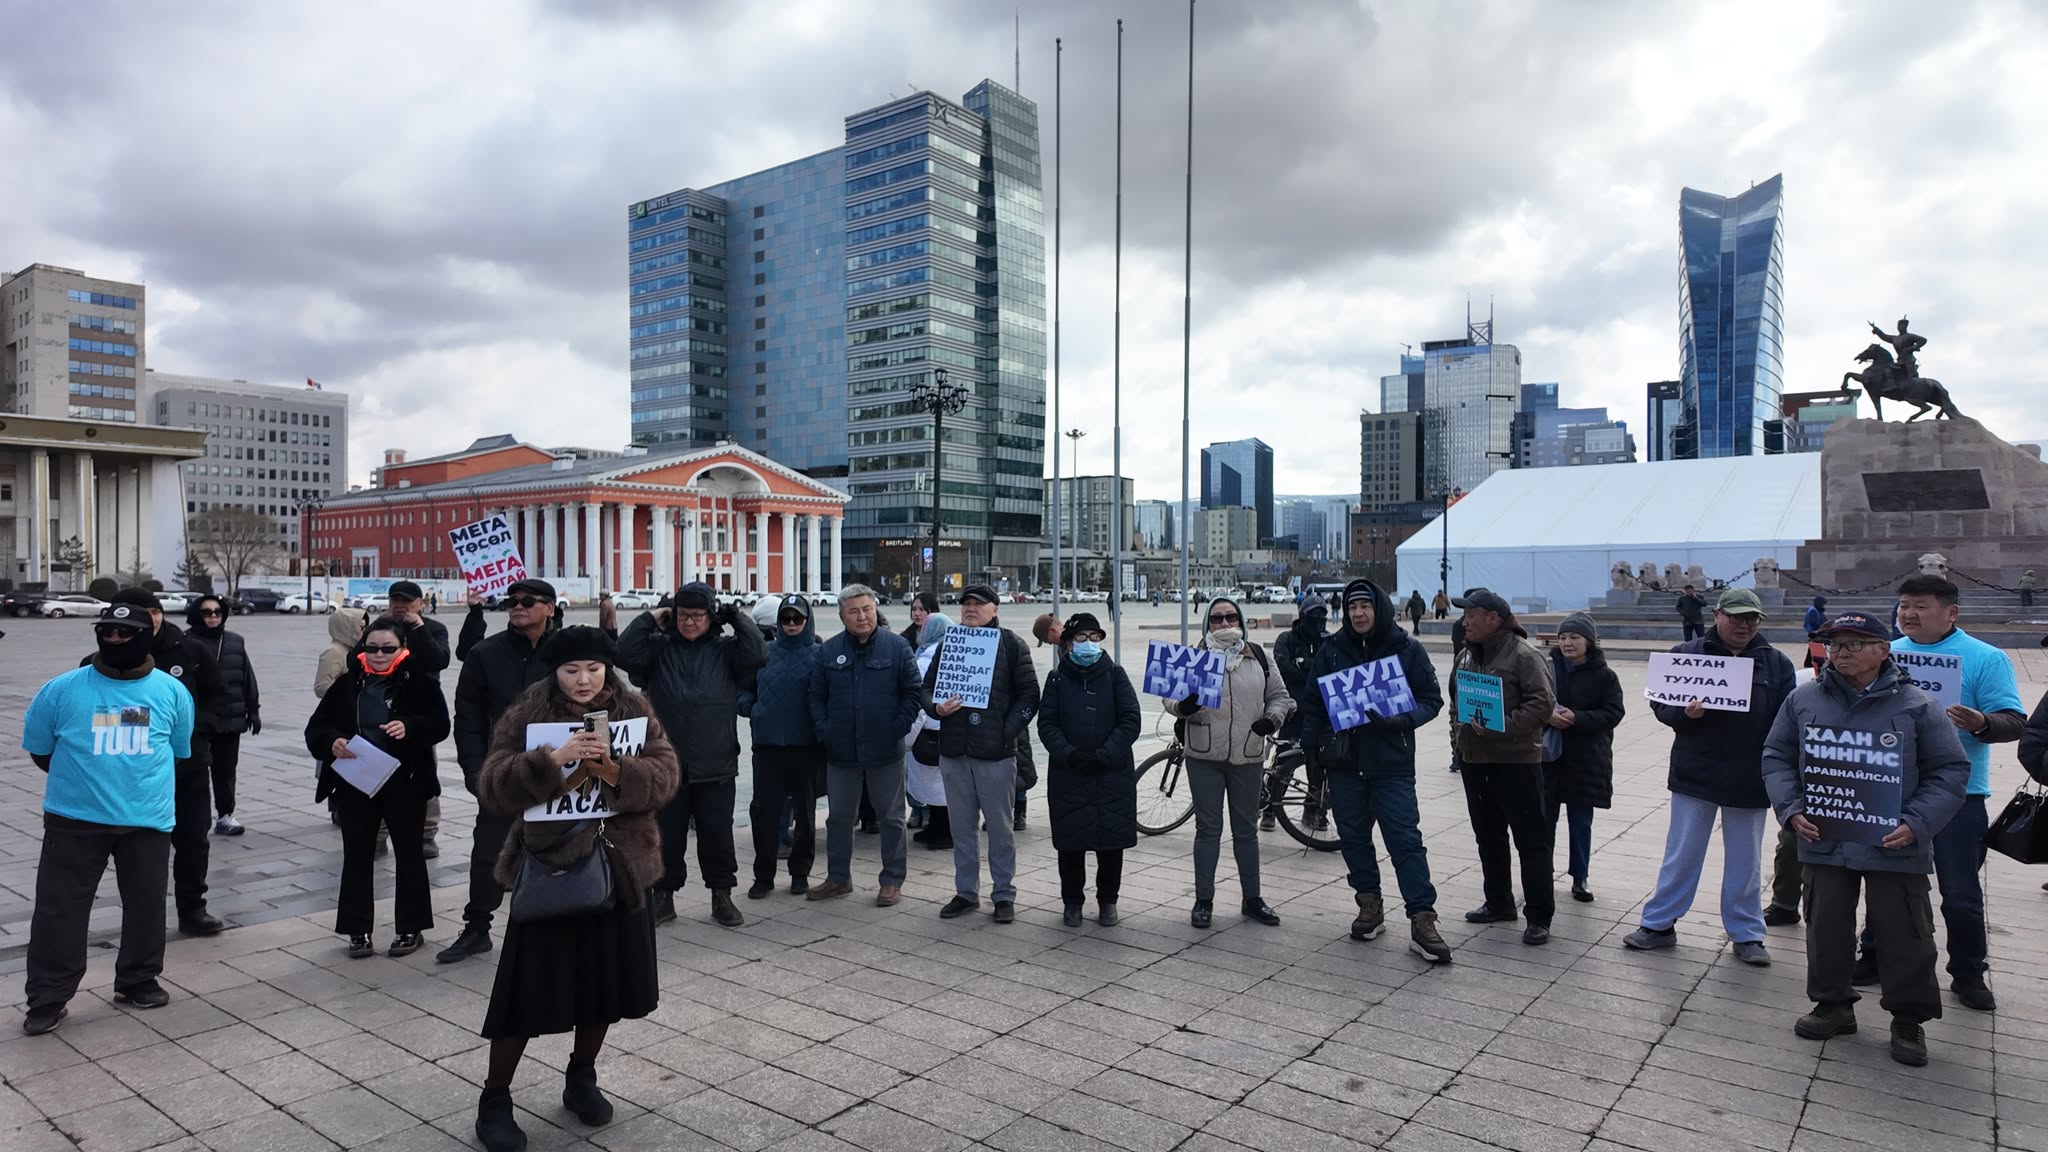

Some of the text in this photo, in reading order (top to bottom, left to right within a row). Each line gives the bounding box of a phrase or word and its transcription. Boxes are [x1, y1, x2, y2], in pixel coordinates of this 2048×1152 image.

[450, 517, 507, 544] МЕГА
[455, 531, 512, 556] ТӨСӨЛ
[464, 556, 522, 584] МЕГА
[945, 635, 966, 644] ГОЛ
[947, 626, 998, 638] ГАНЦХАН
[943, 645, 985, 655] ДЭЭРЭЭ
[1150, 640, 1226, 673] ТУУЛ
[941, 654, 966, 663] ЗАМ
[1672, 657, 1725, 668] ХАТАН
[1888, 653, 1958, 669] АНЦХАН
[939, 672, 973, 682] ТЭНЭГ
[940, 663, 991, 675] БАРЬДАГ
[1317, 654, 1404, 696] ТУУЛ
[936, 681, 989, 695] ДЭЛХИЙД
[1664, 675, 1728, 687] ТУУЛАА
[1647, 691, 1747, 707] ХАМГААЛЪЯ
[91, 726, 154, 755] TUUL
[1805, 726, 1873, 747] ХААН
[1804, 743, 1900, 767] ЧИНГИС
[1804, 765, 1900, 784] АРАВНАЙЛСАН
[1806, 783, 1855, 797] ХАТАН
[1806, 794, 1865, 810] ТУУЛАА
[1806, 806, 1898, 827] ХАМГААЛЪЯ
